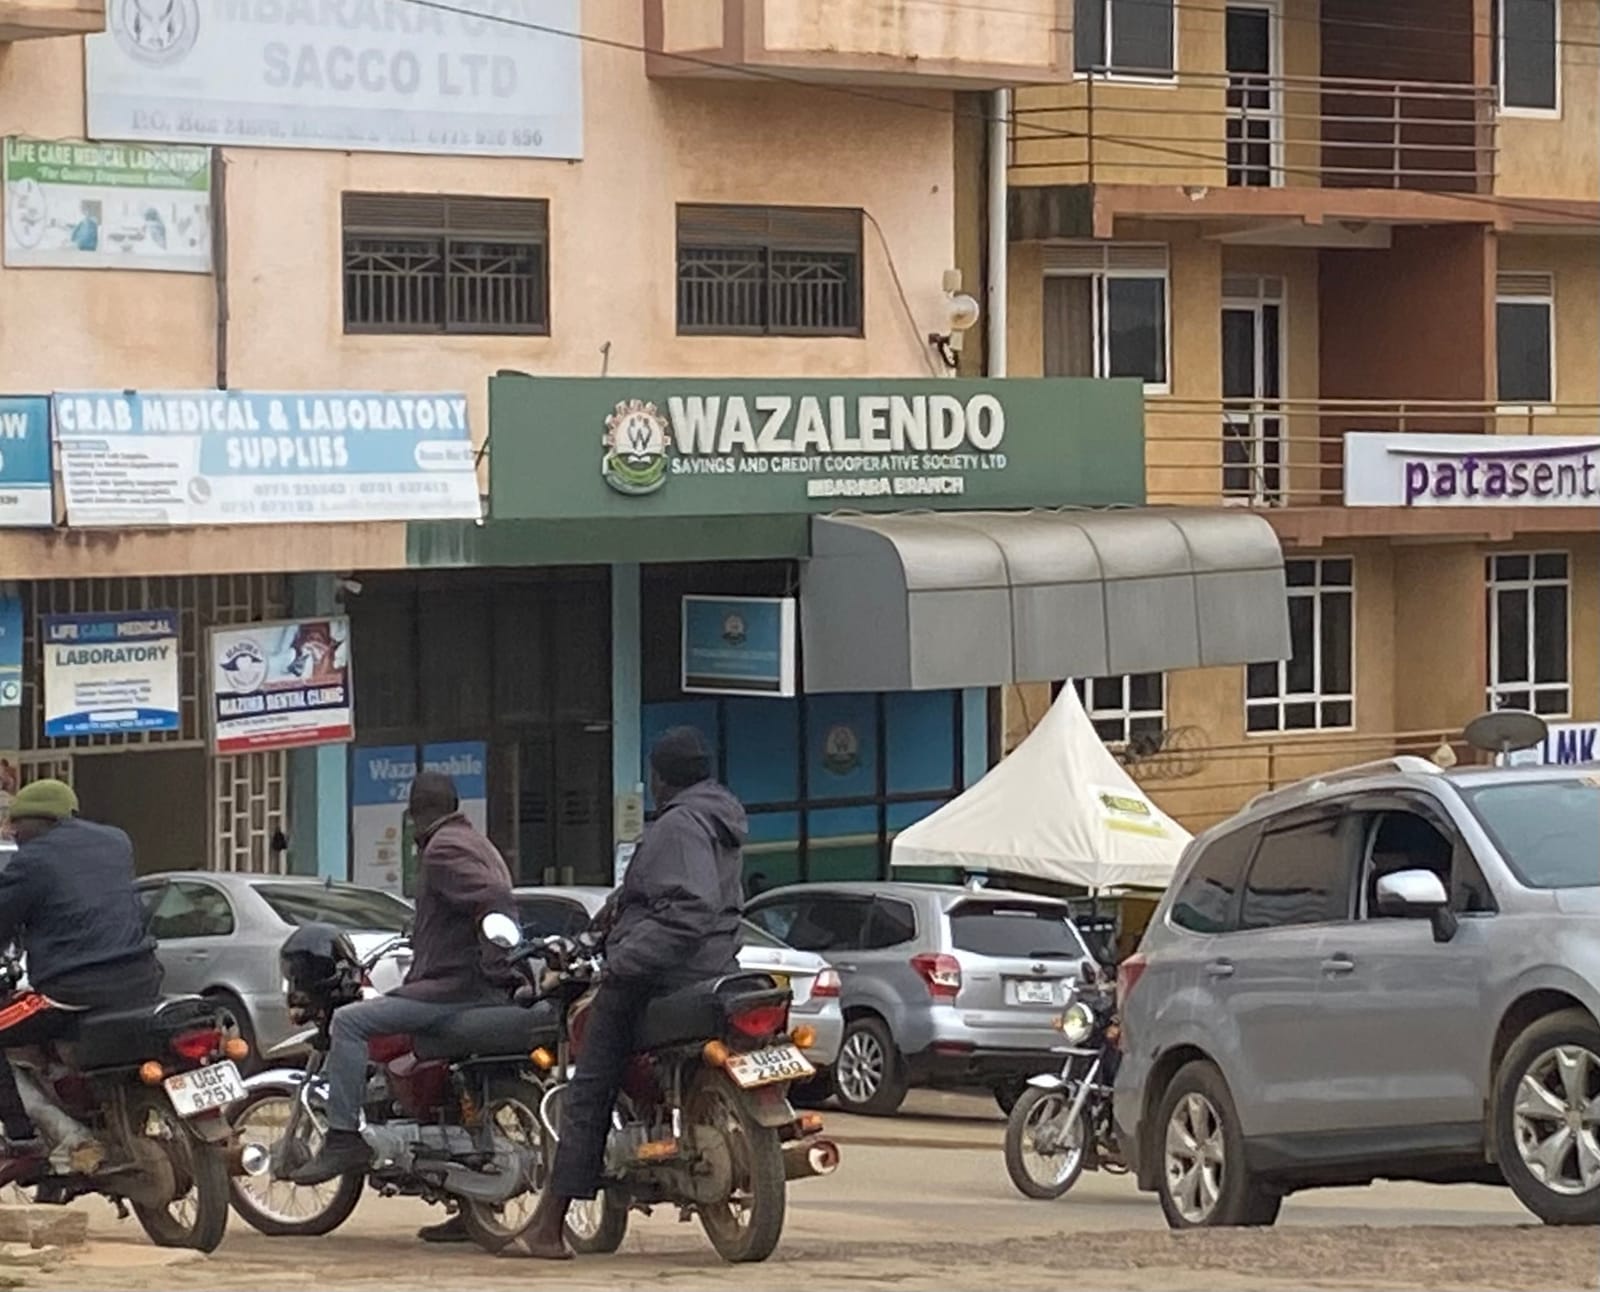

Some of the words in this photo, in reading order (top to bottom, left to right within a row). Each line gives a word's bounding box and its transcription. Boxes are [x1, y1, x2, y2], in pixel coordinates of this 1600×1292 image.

[263, 41, 421, 95] SACCO
[437, 52, 518, 98] LTD
[8, 143, 36, 163] LIFE
[57, 399, 132, 431] CRAB
[142, 399, 260, 431] MEDICAL
[268, 399, 290, 431] &
[297, 399, 467, 430] LABORATORY
[668, 394, 1006, 454] WAZALENDO
[226, 436, 349, 469] SUPPLIES
[671, 457, 735, 474] SAVINGS
[738, 456, 769, 473] AND
[771, 456, 822, 472] CREDIT
[824, 455, 920, 472] COOPERATIVE
[922, 454, 980, 470] SOCIETY
[981, 453, 1007, 469] LTD
[1405, 454, 1600, 506] patasent
[55, 646, 170, 667] LABORATORY
[1543, 728, 1598, 765] LMK
